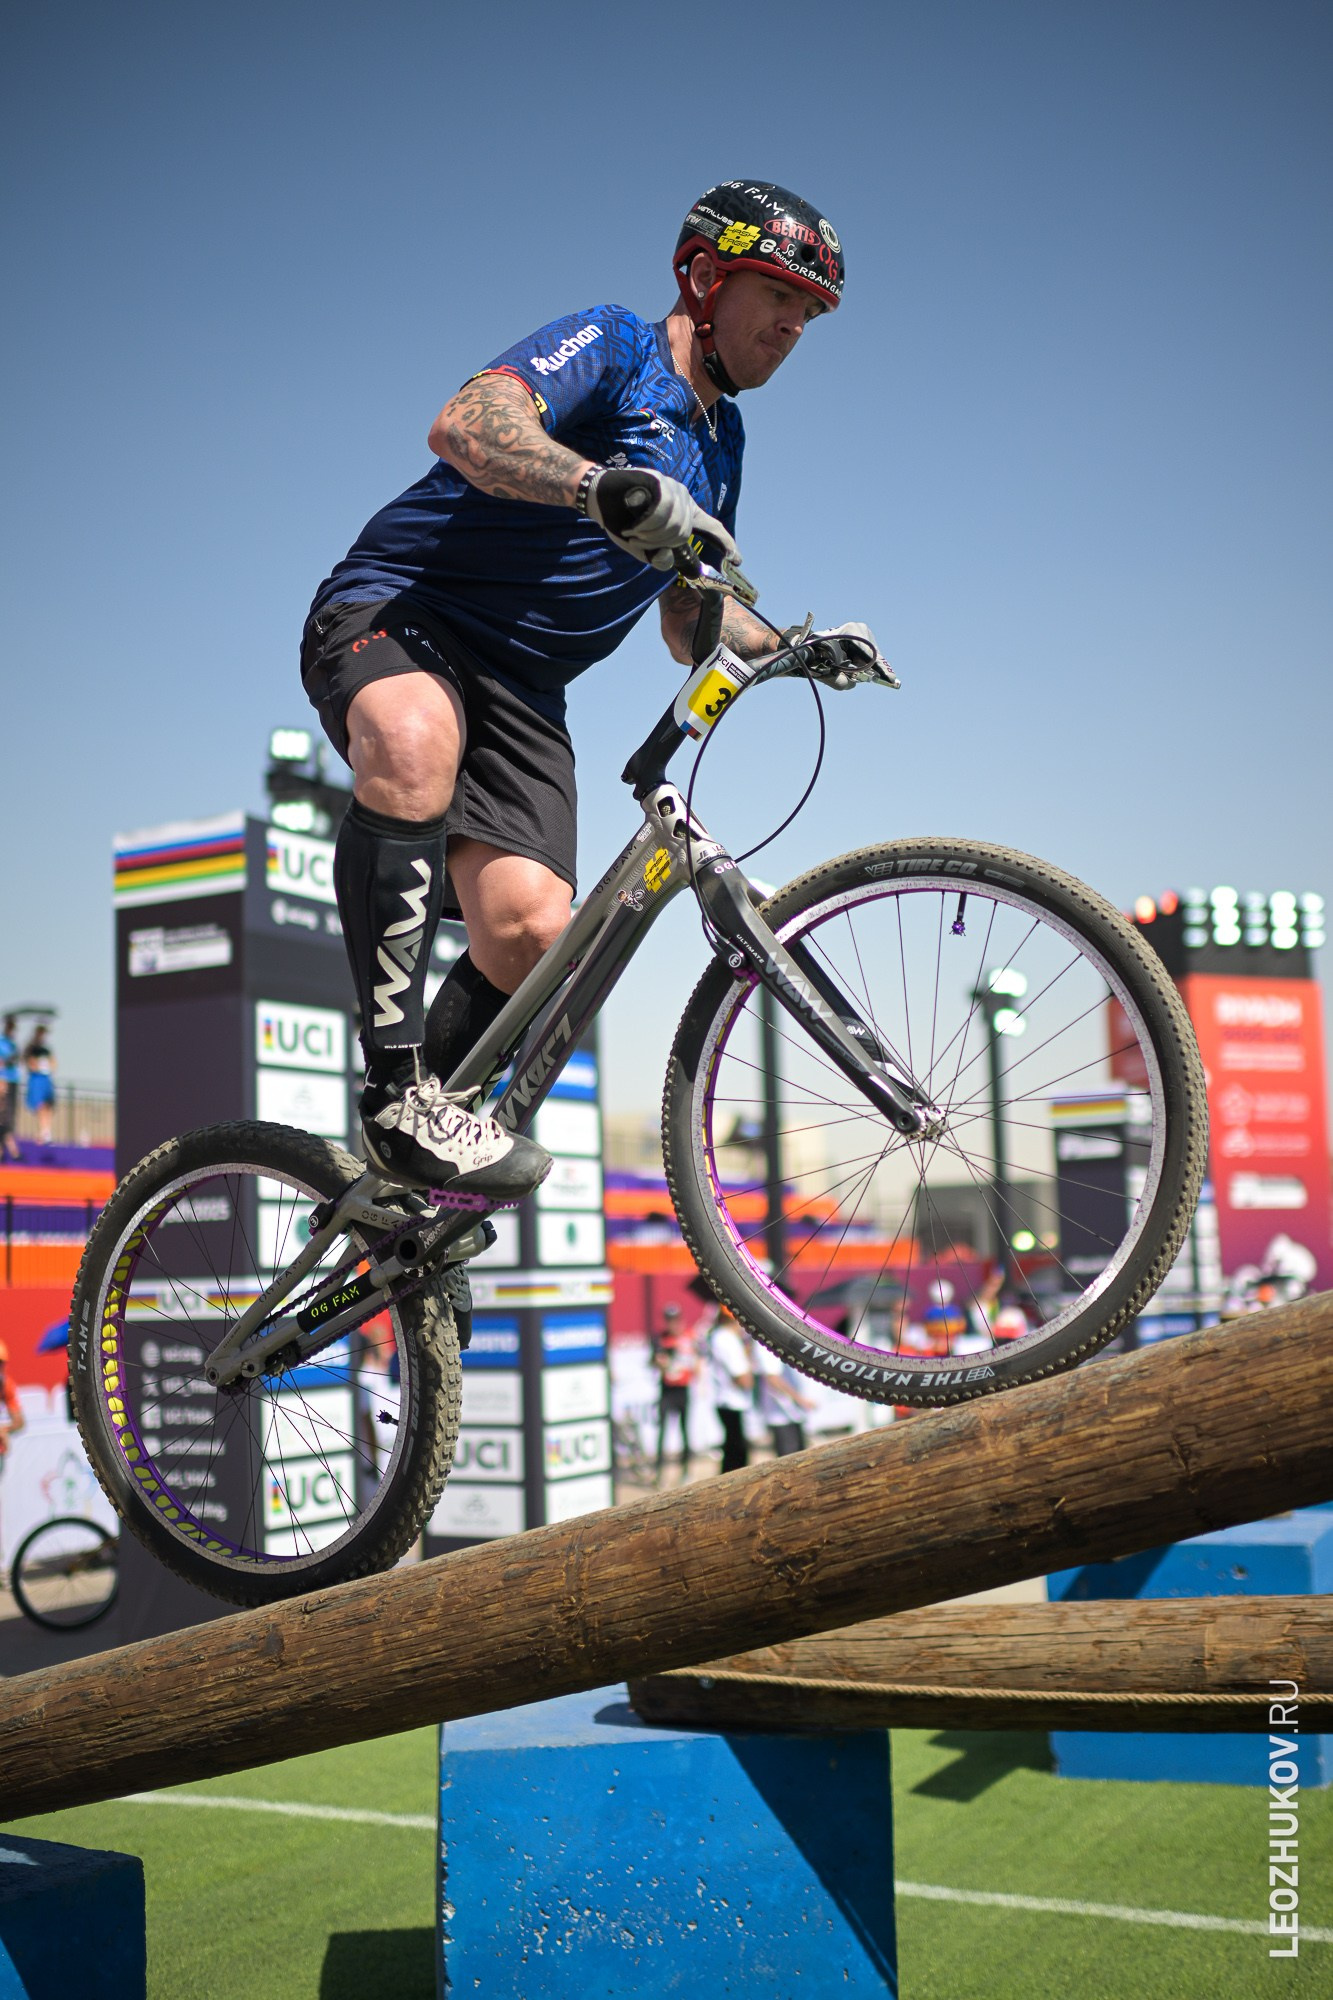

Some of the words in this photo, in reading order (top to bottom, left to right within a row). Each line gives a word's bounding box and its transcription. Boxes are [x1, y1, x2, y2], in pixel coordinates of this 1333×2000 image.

[720, 236, 749, 249] TAGS
[726, 227, 757, 240] HASH
[771, 221, 816, 244] BERTIS
[705, 687, 731, 717] 3
[284, 847, 328, 887] UC
[896, 859, 944, 873] TIRE
[736, 934, 765, 964] ULTIMATE
[277, 1021, 333, 1057] UCI
[472, 1154, 493, 1167] Grip
[311, 1302, 328, 1318] OG
[332, 1285, 360, 1307] FAM
[78, 1323, 89, 1371] T-AM
[800, 1341, 913, 1386] NATIONAL
[920, 1370, 963, 1387] THE
[286, 1471, 341, 1509] UCI
